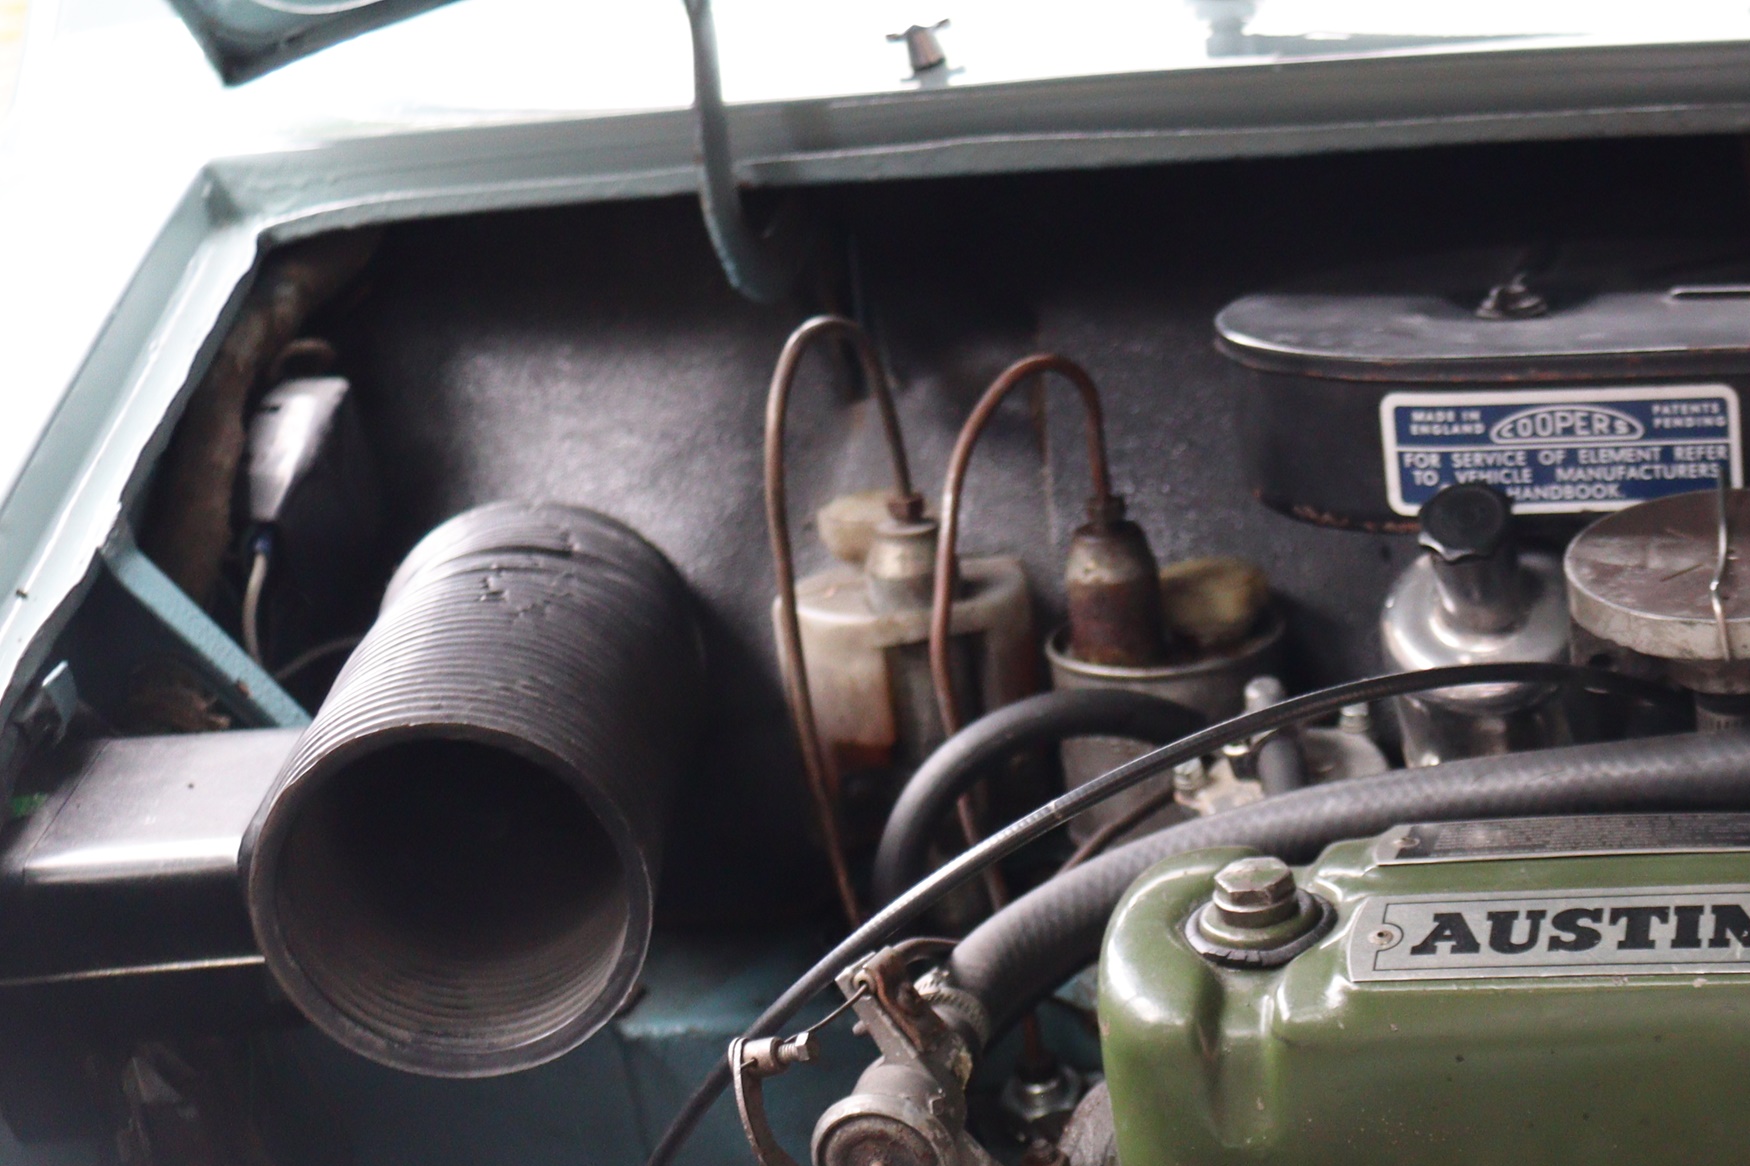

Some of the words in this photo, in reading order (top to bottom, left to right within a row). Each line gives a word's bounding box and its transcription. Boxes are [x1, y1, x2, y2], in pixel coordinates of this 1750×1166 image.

[1652, 402, 1720, 415] PATENTS
[1410, 410, 1456, 422] MADE
[1461, 410, 1480, 421] IN
[1652, 416, 1726, 428] PENDING
[1410, 423, 1486, 435] ENGLAND
[1403, 452, 1441, 468] FOR
[1451, 450, 1526, 468] SERVICE
[1538, 449, 1566, 466] OF
[1578, 447, 1662, 464] ELEMENT
[1674, 446, 1728, 461] REFER
[1412, 470, 1439, 486] TO
[1454, 468, 1533, 484] VEHICLE
[1555, 464, 1720, 482] MANUFACTURERS
